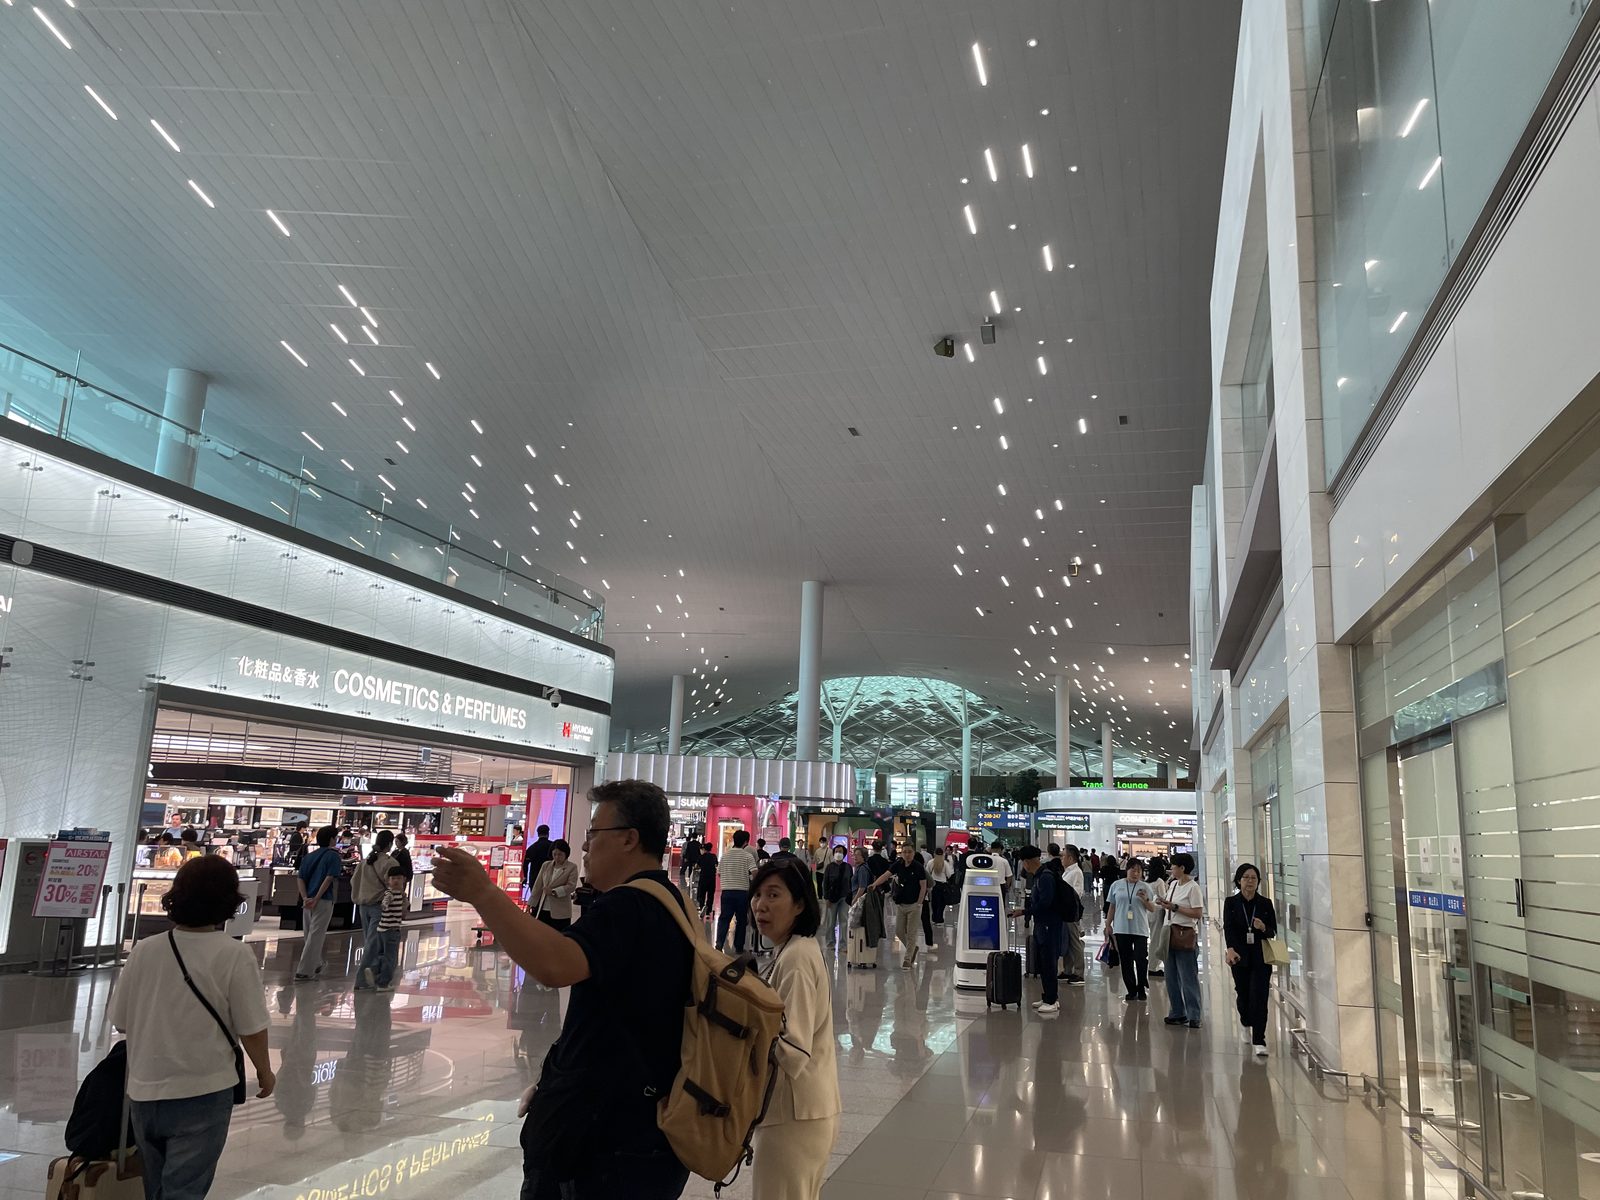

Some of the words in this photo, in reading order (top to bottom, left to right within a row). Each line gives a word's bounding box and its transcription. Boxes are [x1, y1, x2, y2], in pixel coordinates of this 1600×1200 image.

[238, 655, 320, 689] 化粧品&香水
[334, 669, 440, 712] COSMETICS
[441, 688, 452, 715] &
[454, 695, 527, 730] PERFUMES
[342, 775, 368, 791] DIOR
[1117, 780, 1149, 789] Lounge
[65, 848, 107, 858] AIRSTAR
[43, 883, 78, 904] 30%
